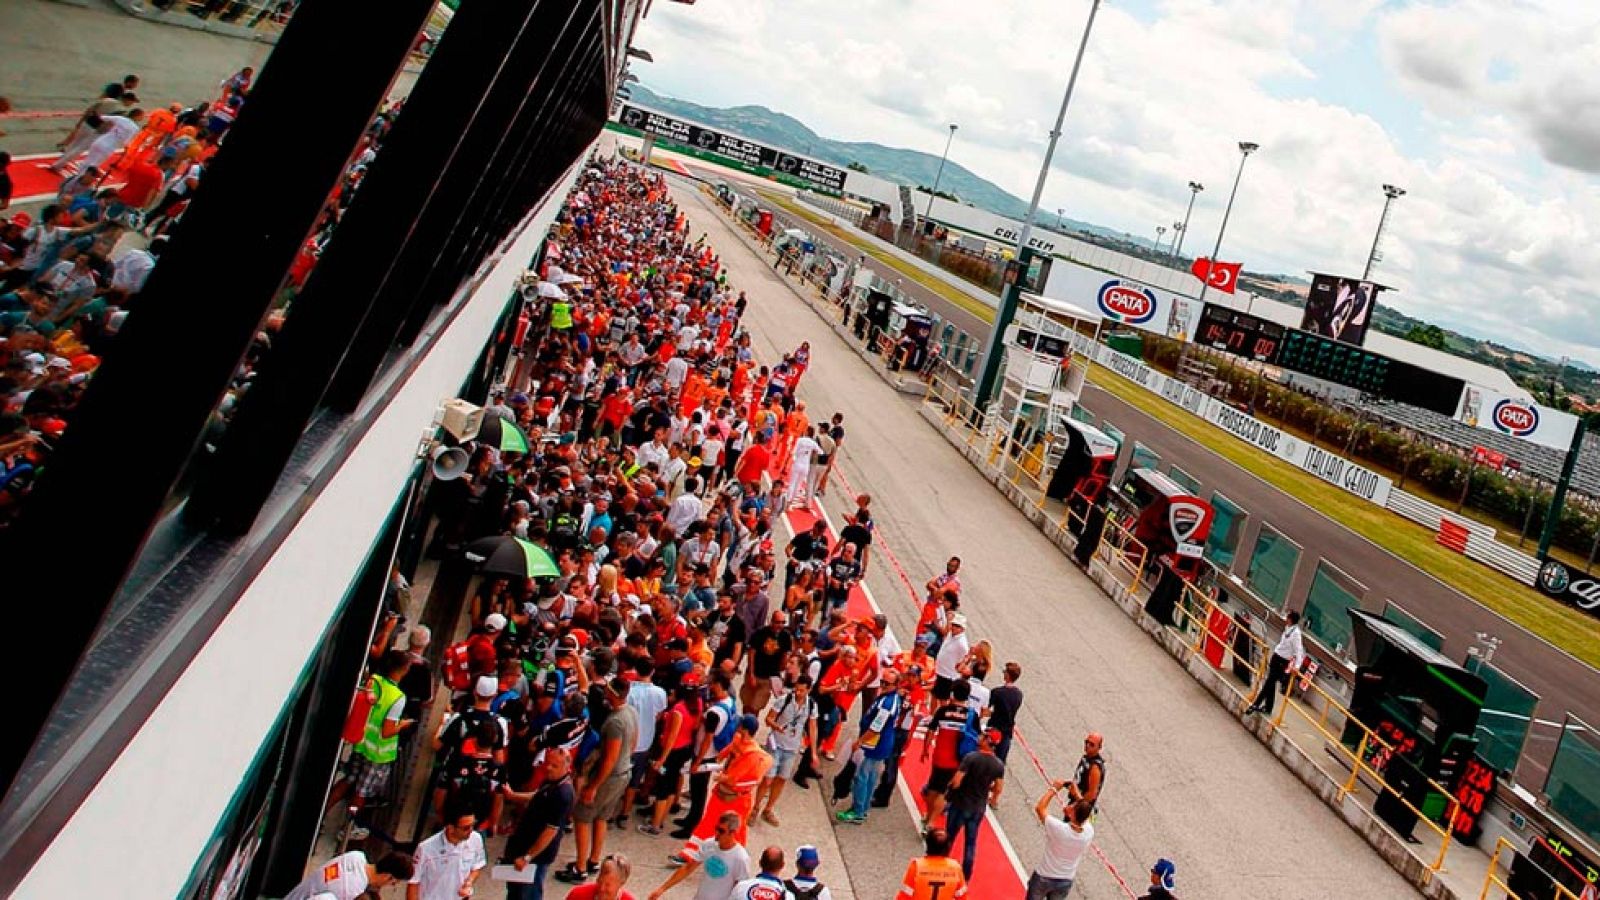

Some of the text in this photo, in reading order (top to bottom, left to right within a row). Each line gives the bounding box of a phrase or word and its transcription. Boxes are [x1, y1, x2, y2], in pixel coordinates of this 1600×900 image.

[648, 114, 690, 135] NILOX
[720, 135, 761, 156] NILOX
[801, 161, 841, 180] NILOX
[1108, 290, 1145, 313] PATA
[1501, 407, 1529, 427] PATA
[1218, 405, 1281, 452] PROSECCO DOC
[1303, 446, 1379, 499] ITALIAN GENIO
[928, 881, 946, 900] T
